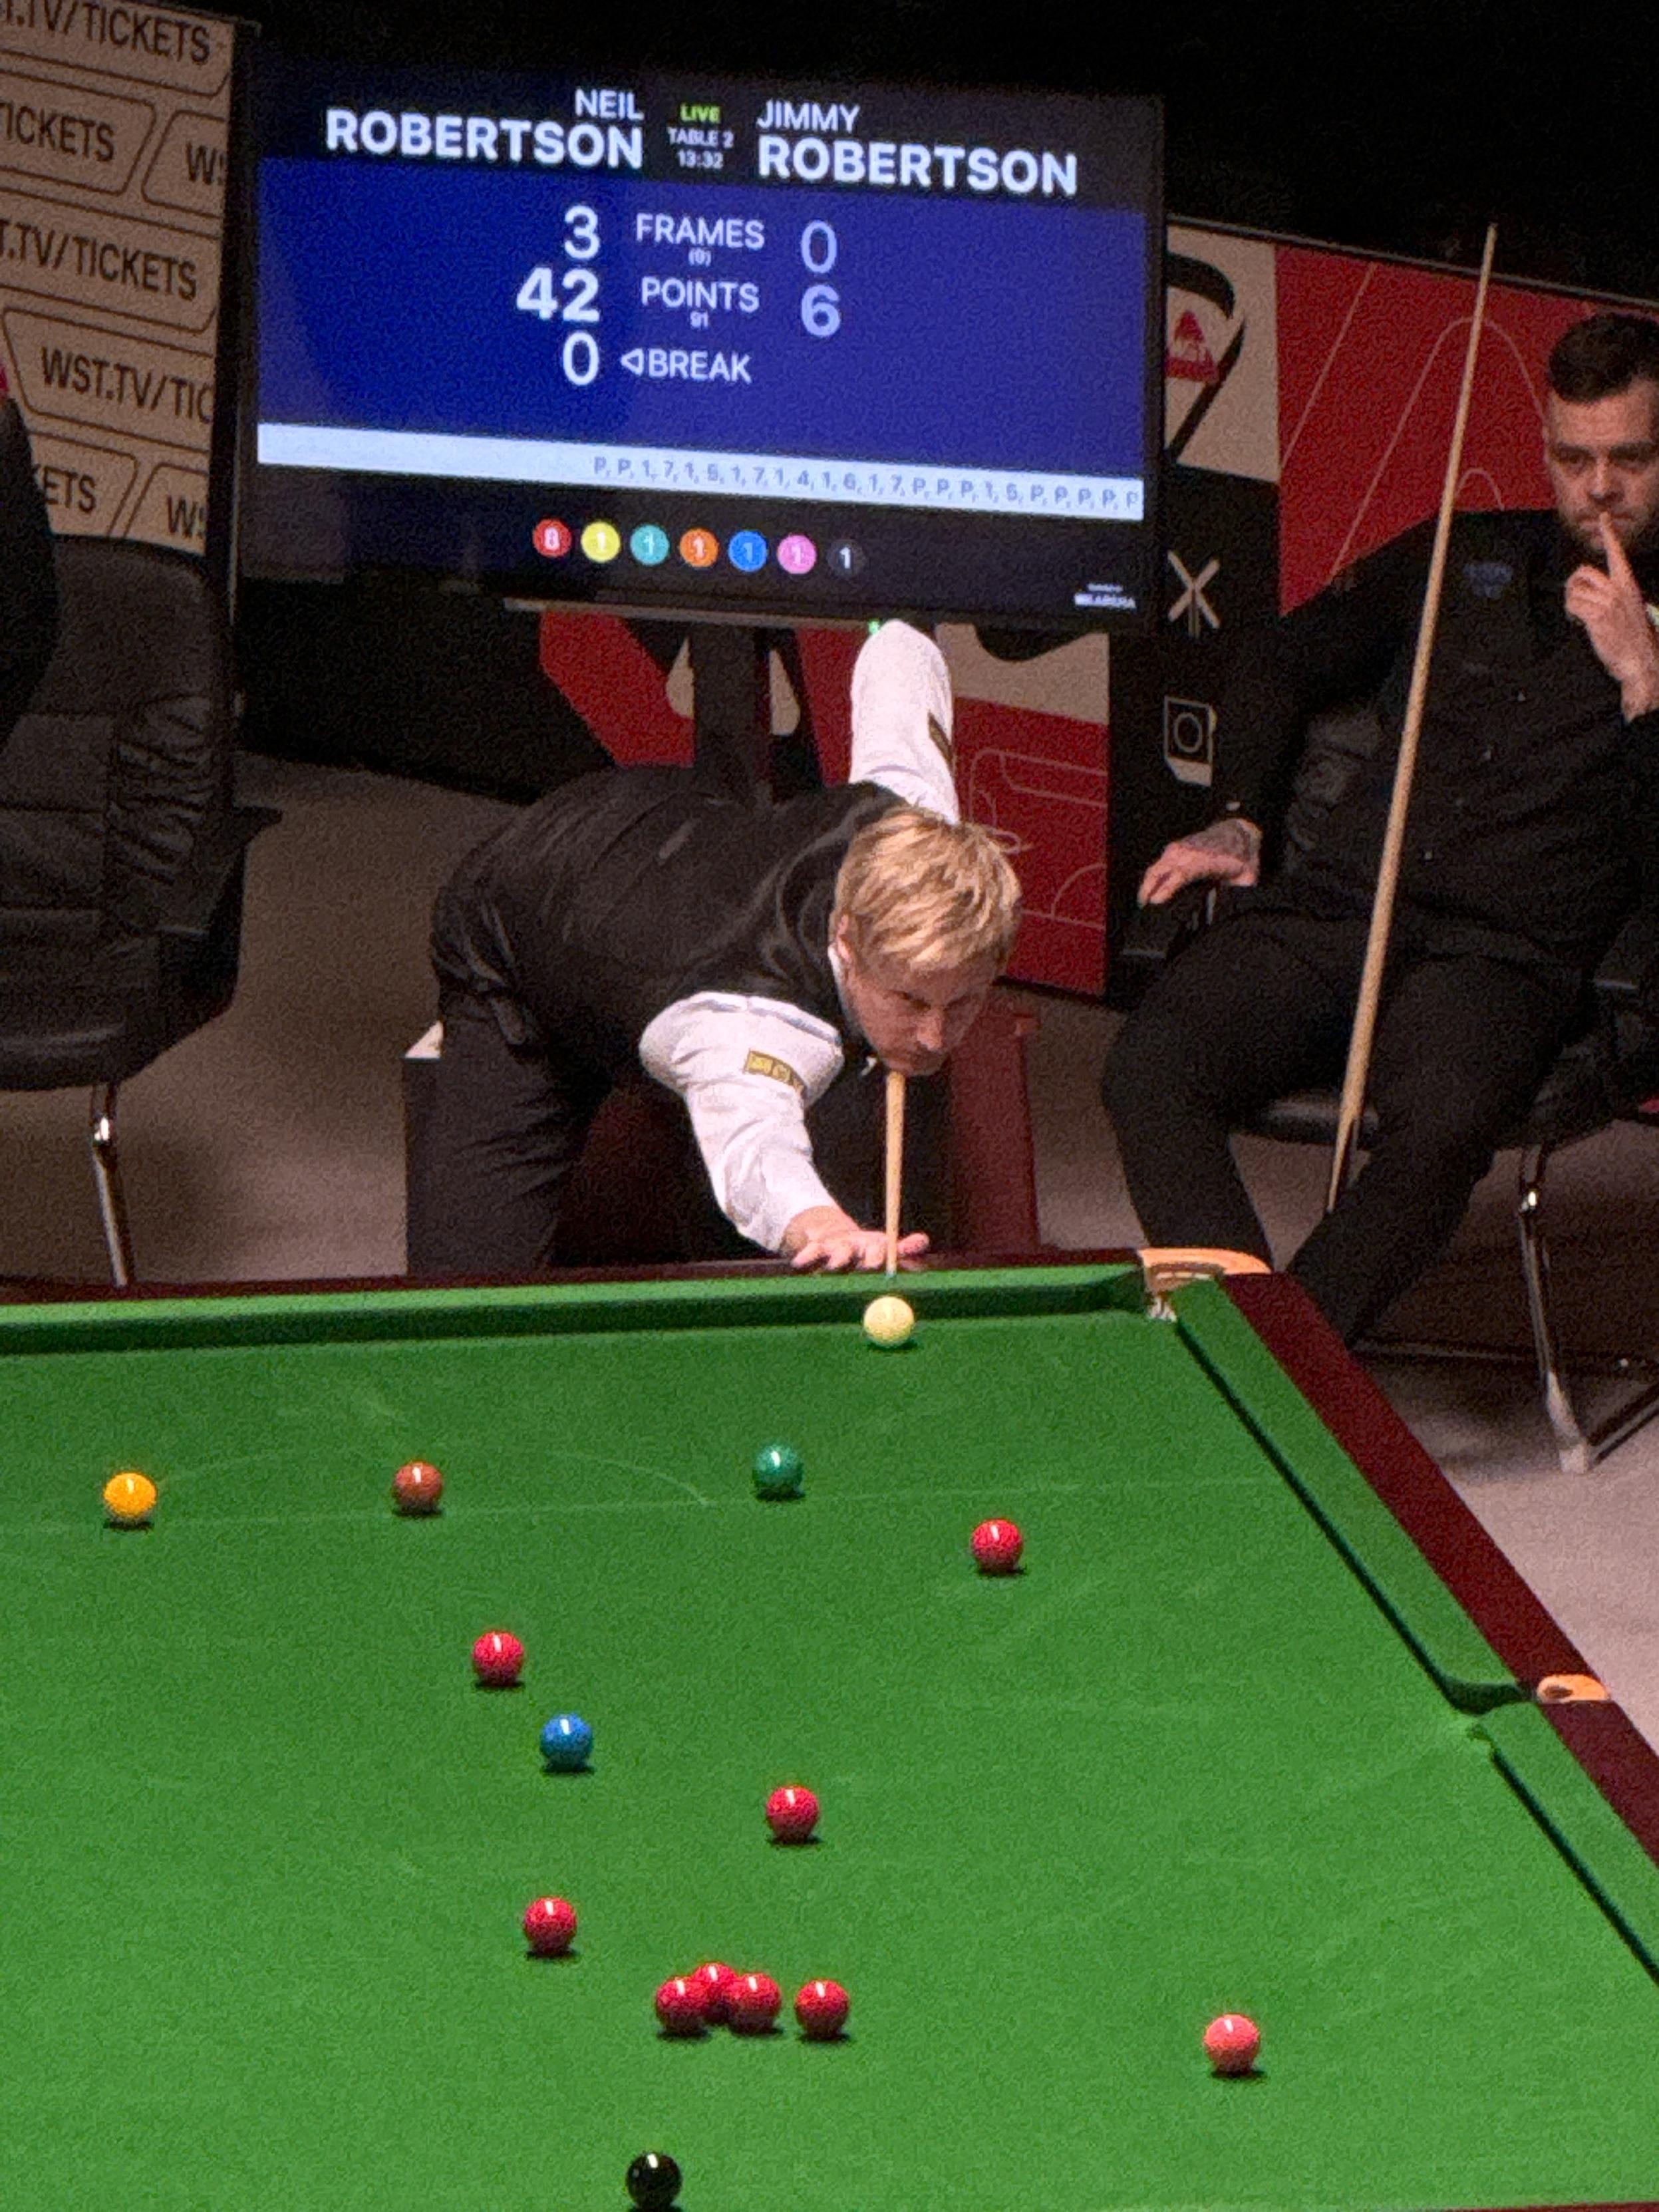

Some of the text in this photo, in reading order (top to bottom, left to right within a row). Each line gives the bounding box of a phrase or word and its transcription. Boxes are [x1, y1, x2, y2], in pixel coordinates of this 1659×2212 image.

[575, 88, 644, 120] NEIL
[680, 103, 720, 124] LIVE
[756, 100, 860, 134] JIMMY
[0, 102, 115, 162] ICKETS
[325, 108, 644, 169] ROBERTSON
[667, 126, 734, 148] TABLE 2
[758, 135, 1078, 196] ROBERTSON
[564, 205, 837, 273] 3 FRAMES 0
[516, 267, 841, 337] 42 POINTS 6
[563, 331, 752, 386] 0 BREAK
[597, 531, 607, 552] 1
[644, 533, 655, 556] 1
[694, 537, 704, 557] 1
[744, 542, 754, 561] 1
[792, 544, 803, 565] 1
[839, 546, 851, 569] 1
